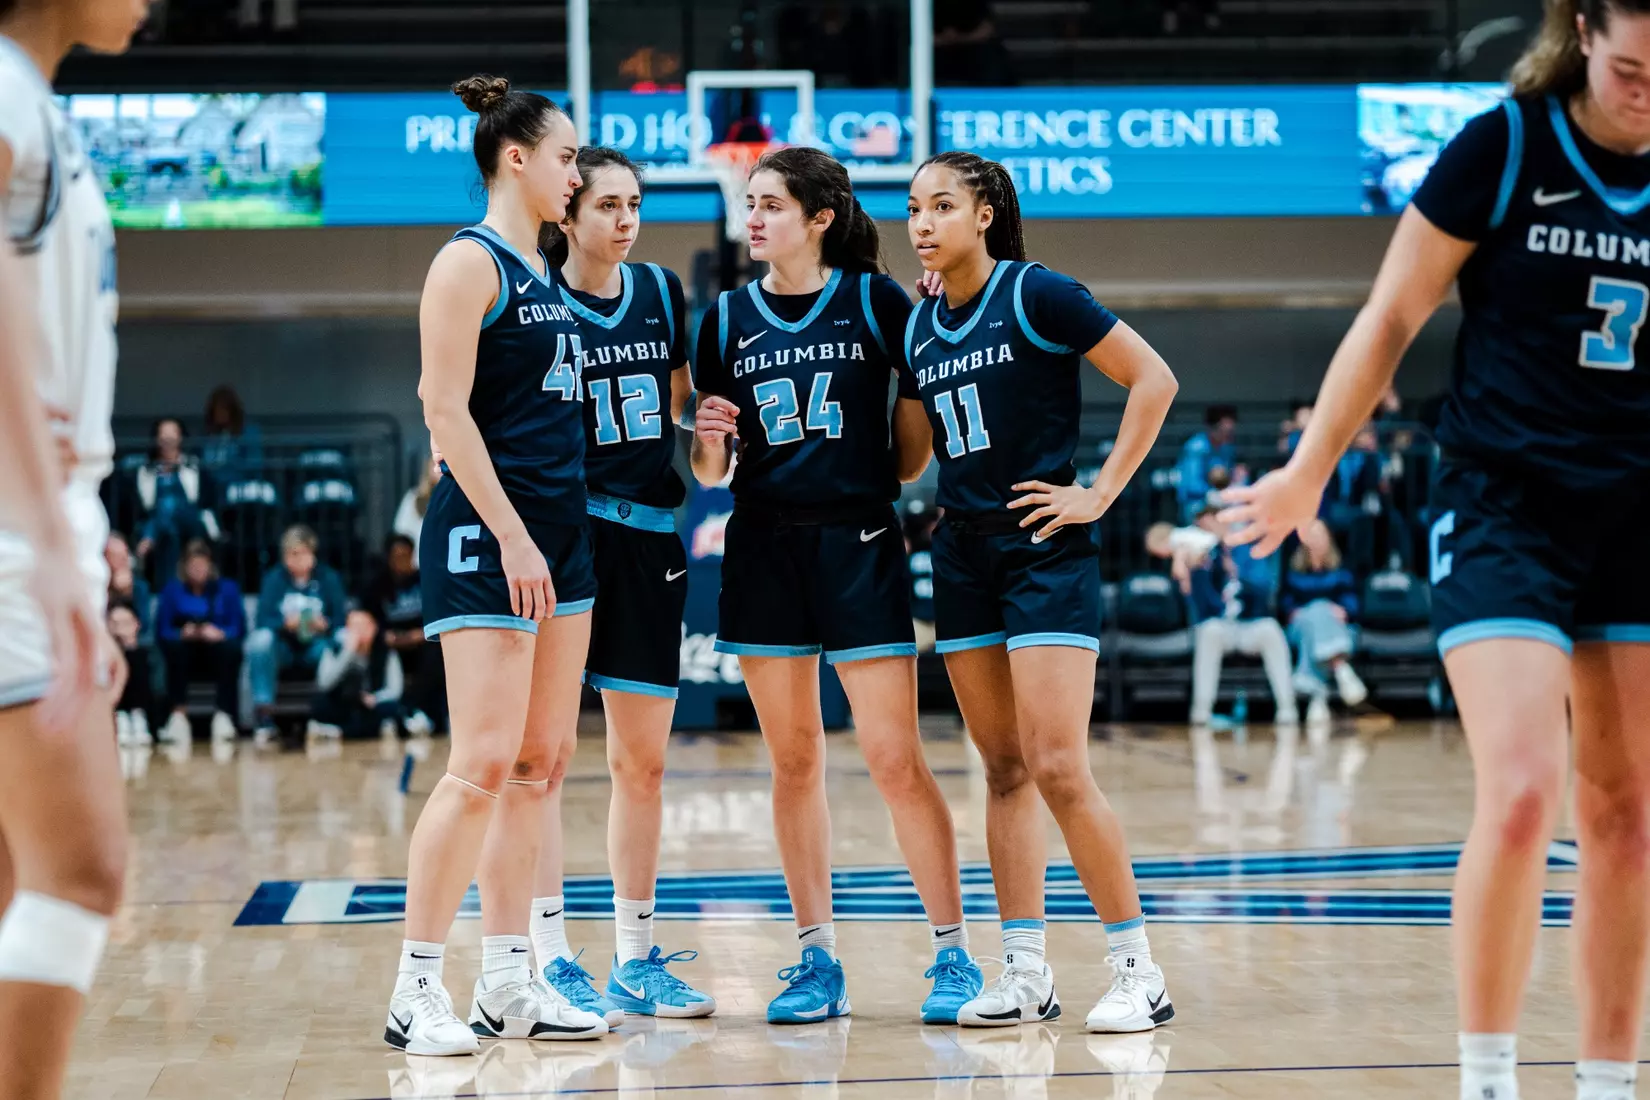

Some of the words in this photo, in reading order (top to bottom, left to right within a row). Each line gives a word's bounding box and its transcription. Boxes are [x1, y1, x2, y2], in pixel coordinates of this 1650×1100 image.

[1117, 108, 1282, 148] CENTER
[1527, 224, 1650, 267] COLUM
[517, 303, 575, 325] COLUM
[1578, 275, 1650, 371] 3
[582, 341, 670, 368] LUMBIA
[733, 342, 865, 379] COLUMBIA
[587, 373, 662, 446] 12
[752, 371, 844, 446] 24
[934, 382, 991, 459] 11
[447, 524, 481, 574] C
